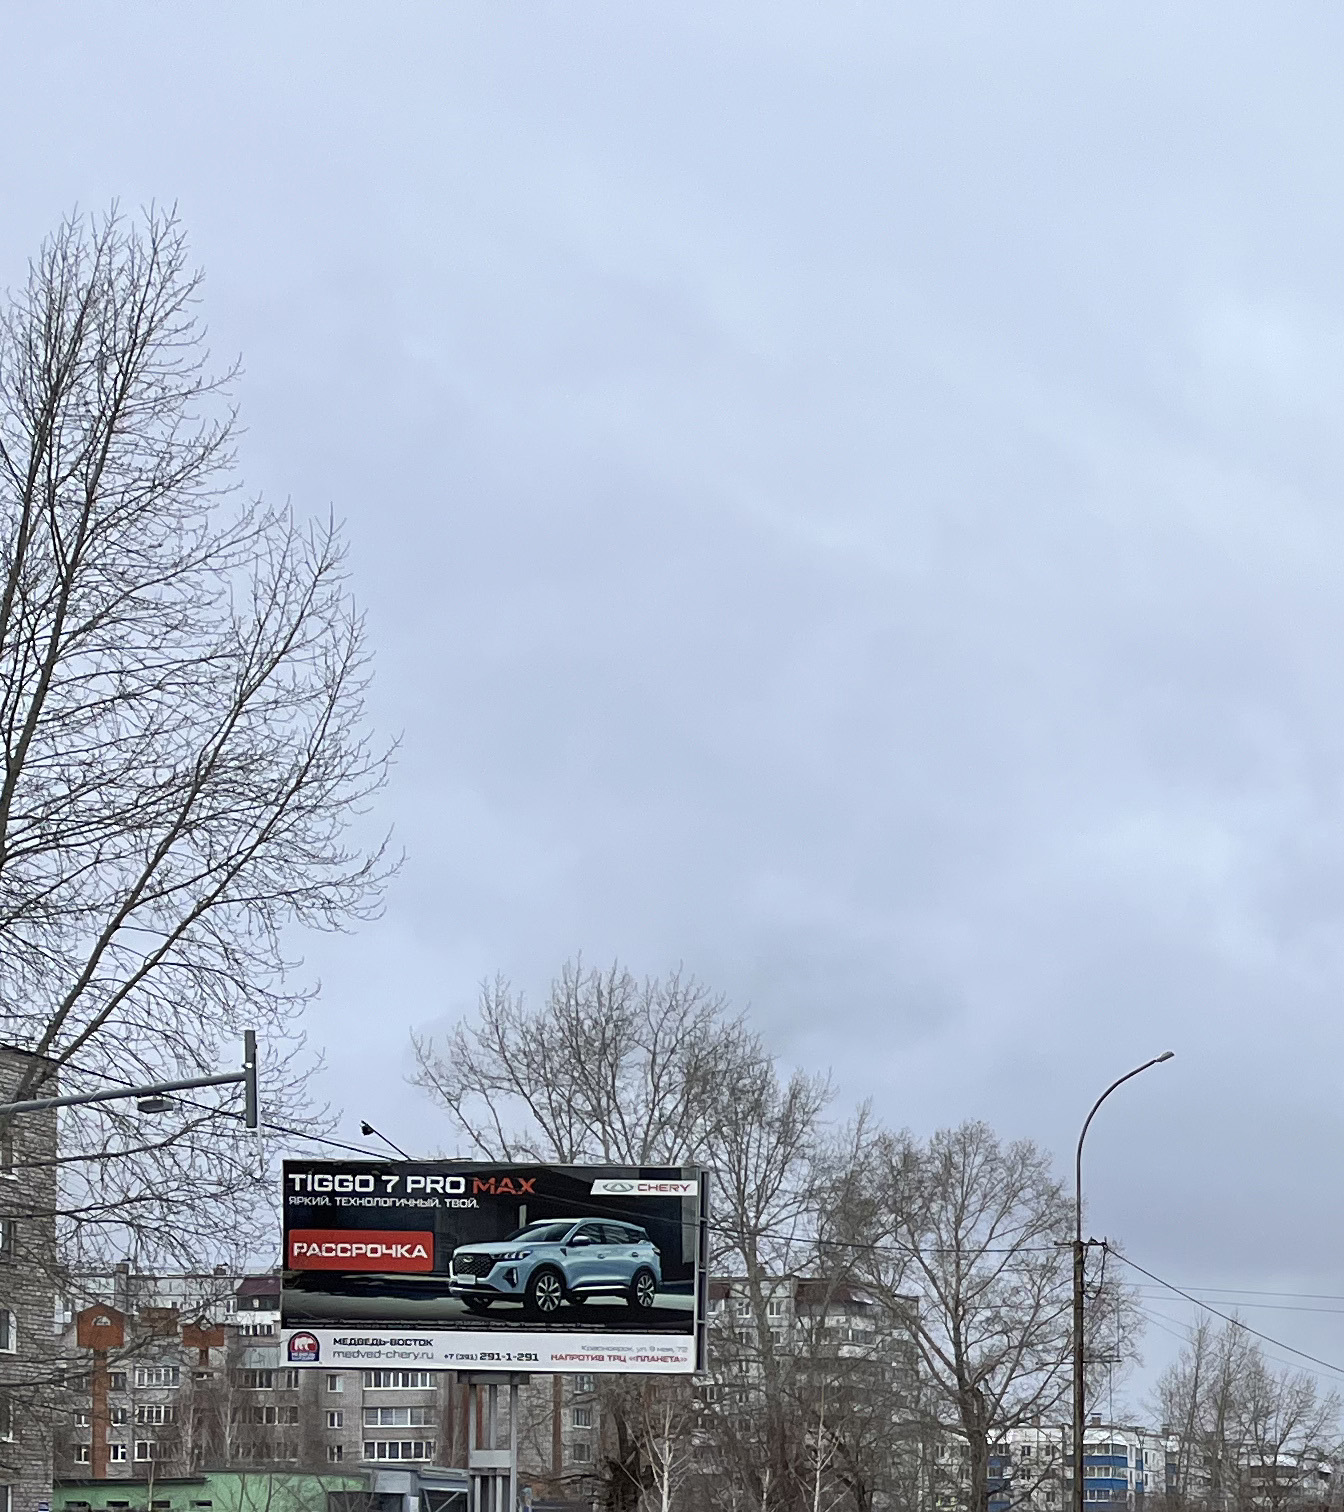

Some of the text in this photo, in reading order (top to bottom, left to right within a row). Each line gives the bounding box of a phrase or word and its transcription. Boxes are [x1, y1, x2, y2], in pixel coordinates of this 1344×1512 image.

[288, 1173, 537, 1195] TIGGO 7 PRO MAX
[637, 1183, 691, 1193] CHERY
[288, 1195, 333, 1206] ЯРКИЙ.
[444, 1197, 480, 1209] ТВОЙ.
[293, 1243, 428, 1259] РАССРОЧКА
[332, 1350, 434, 1361] medved-chery.ru
[479, 1353, 539, 1362] 291-1-291
